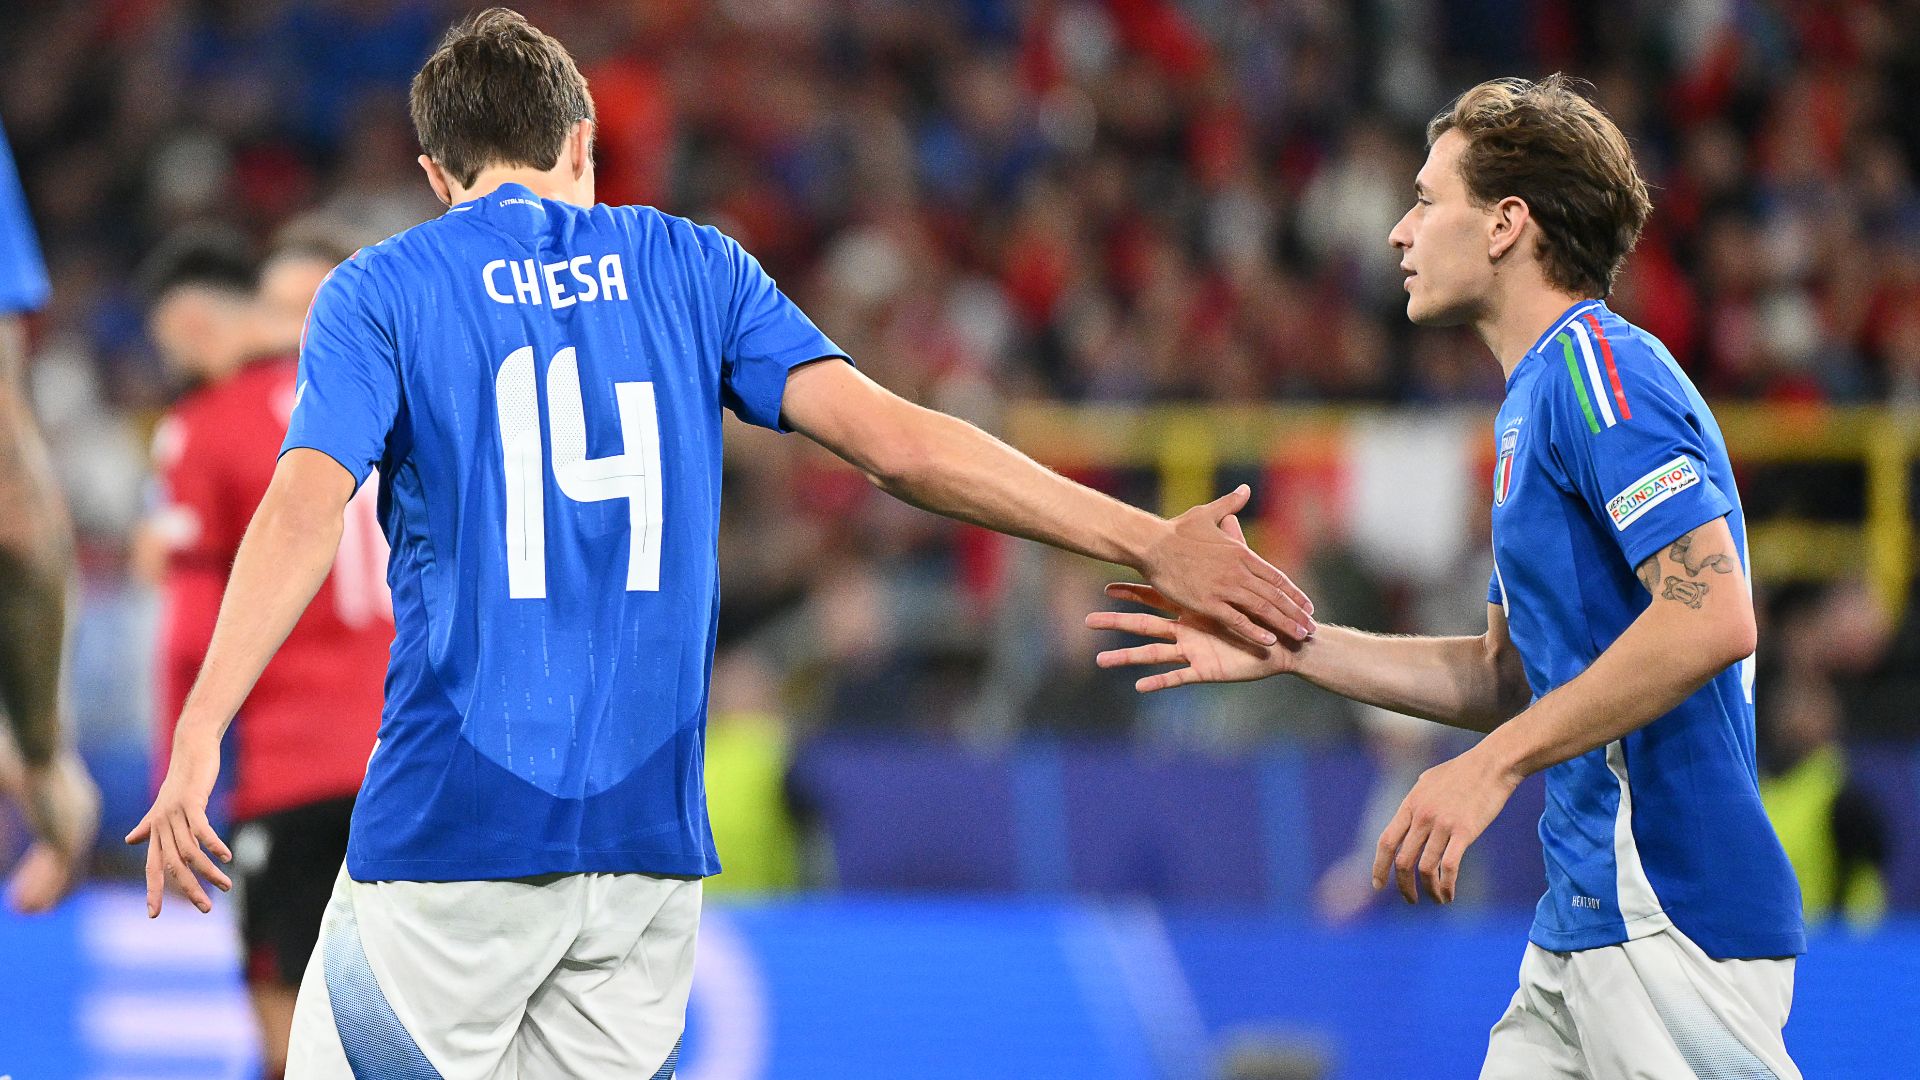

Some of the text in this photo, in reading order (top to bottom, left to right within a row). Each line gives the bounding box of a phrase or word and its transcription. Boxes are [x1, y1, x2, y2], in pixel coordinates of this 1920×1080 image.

[482, 254, 628, 309] CHESA
[495, 345, 663, 599] 14
[1612, 464, 1693, 519] FOUNDATION
[1608, 495, 1626, 511] UEFA
